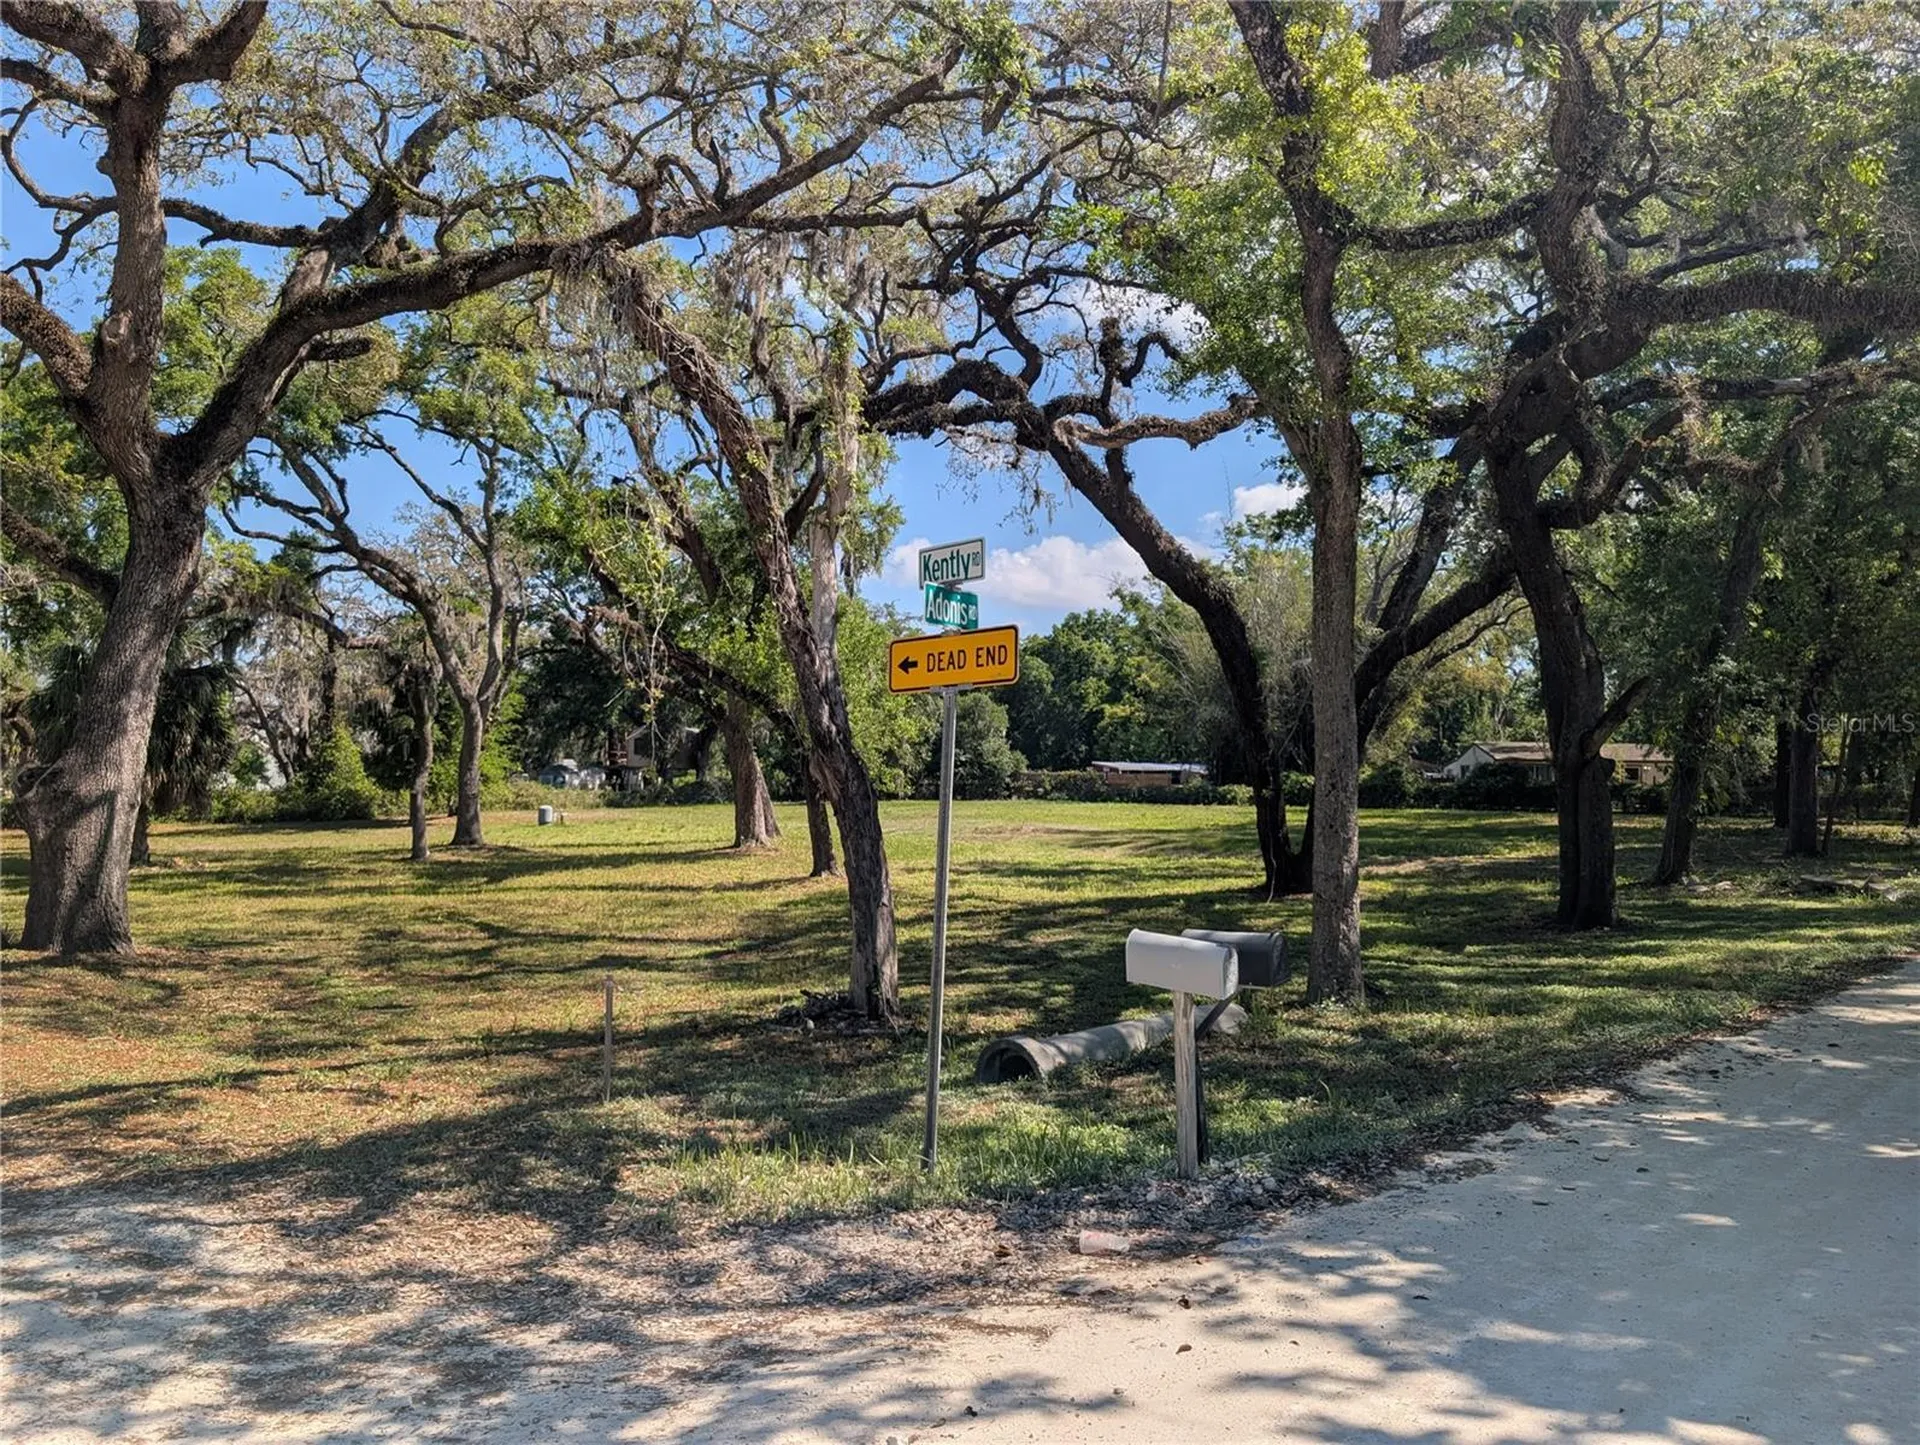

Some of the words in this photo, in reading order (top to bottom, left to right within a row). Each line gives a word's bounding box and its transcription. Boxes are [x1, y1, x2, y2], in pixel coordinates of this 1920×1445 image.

[923, 549, 970, 581] Kently
[927, 589, 967, 625] Adonis
[927, 649, 967, 672] DEAD
[976, 645, 1008, 668] END
